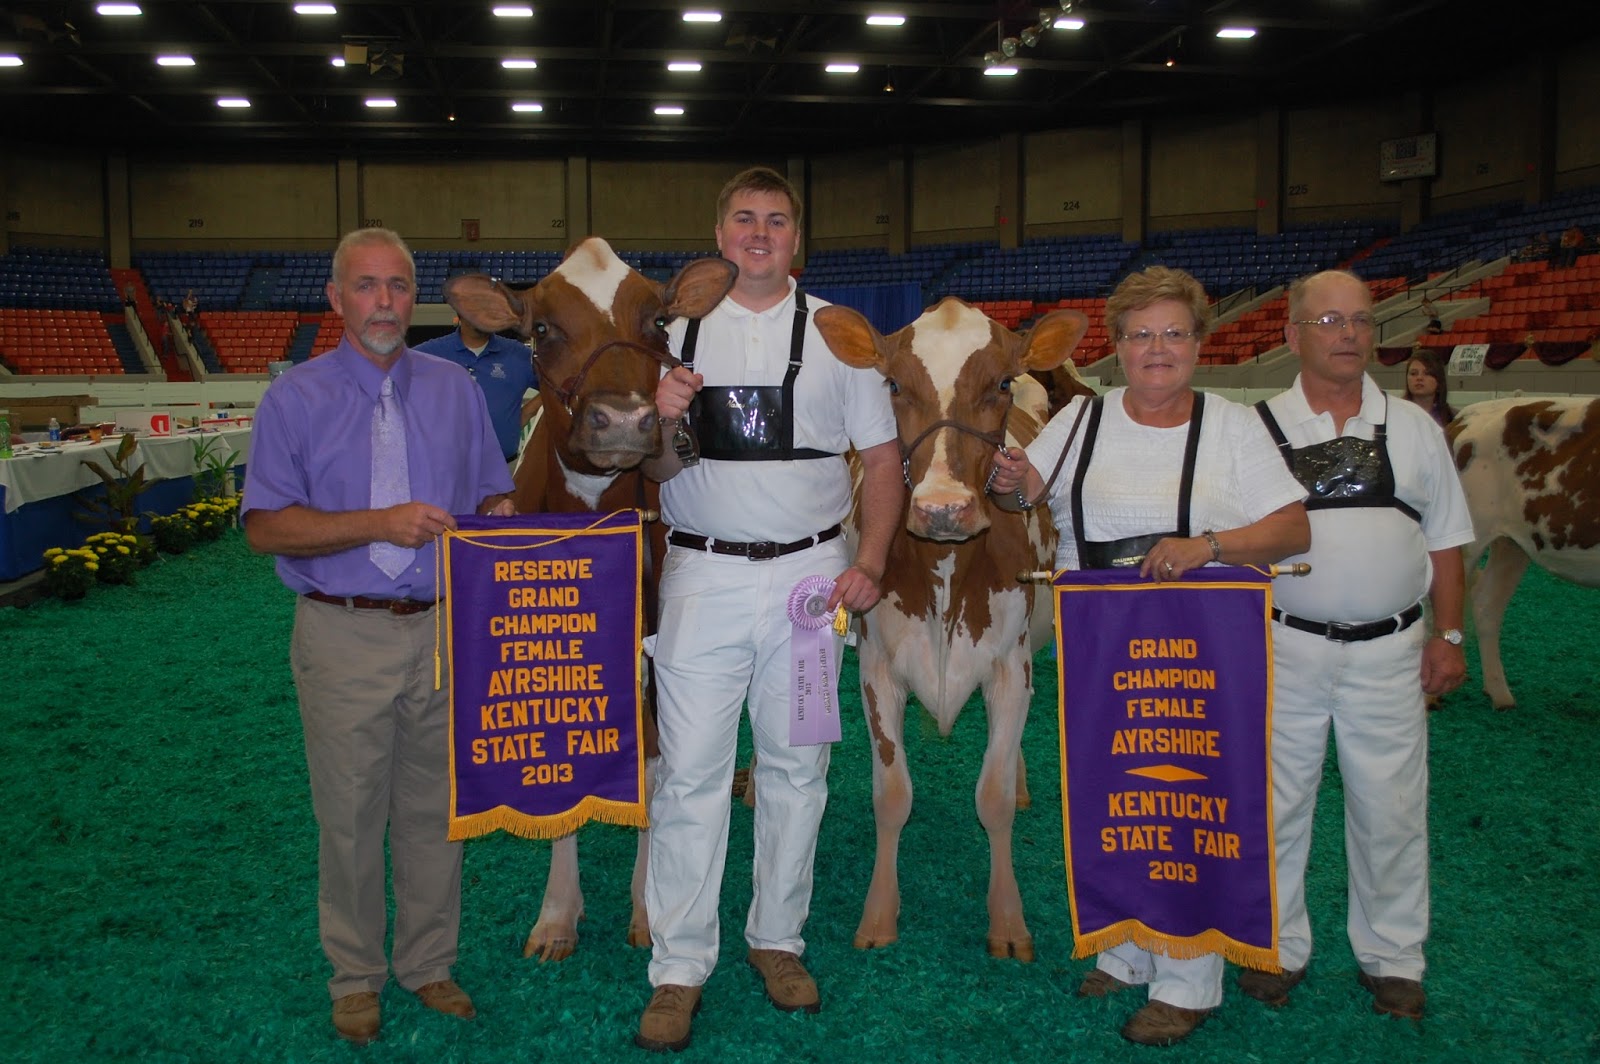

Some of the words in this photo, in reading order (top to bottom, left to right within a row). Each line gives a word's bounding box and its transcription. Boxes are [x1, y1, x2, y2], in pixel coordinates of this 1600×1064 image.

[1288, 185, 1308, 196] 225
[1063, 201, 1080, 211] 224
[188, 218, 204, 228] 219
[364, 218, 382, 228] 220
[875, 215, 889, 225] 223
[494, 558, 593, 582] RESERVE
[509, 586, 580, 609] GRAND
[490, 613, 597, 637] CHAMPION
[501, 639, 583, 663] FEMALE
[1129, 639, 1197, 659] GRAND
[488, 664, 604, 697] AYRSHIRE
[1113, 668, 1216, 691] CHAMPION
[481, 695, 609, 730] KENTUCKY
[1127, 698, 1206, 719] FEMALE
[472, 731, 546, 765] STATE
[567, 727, 619, 756] FAIR
[1111, 728, 1220, 757] AYRSHIRE
[522, 763, 574, 786] 2013
[1108, 791, 1227, 822] KENTUCKY
[1101, 825, 1173, 852] STATE
[1194, 828, 1240, 859] FAIR
[1149, 861, 1197, 883] 2013
